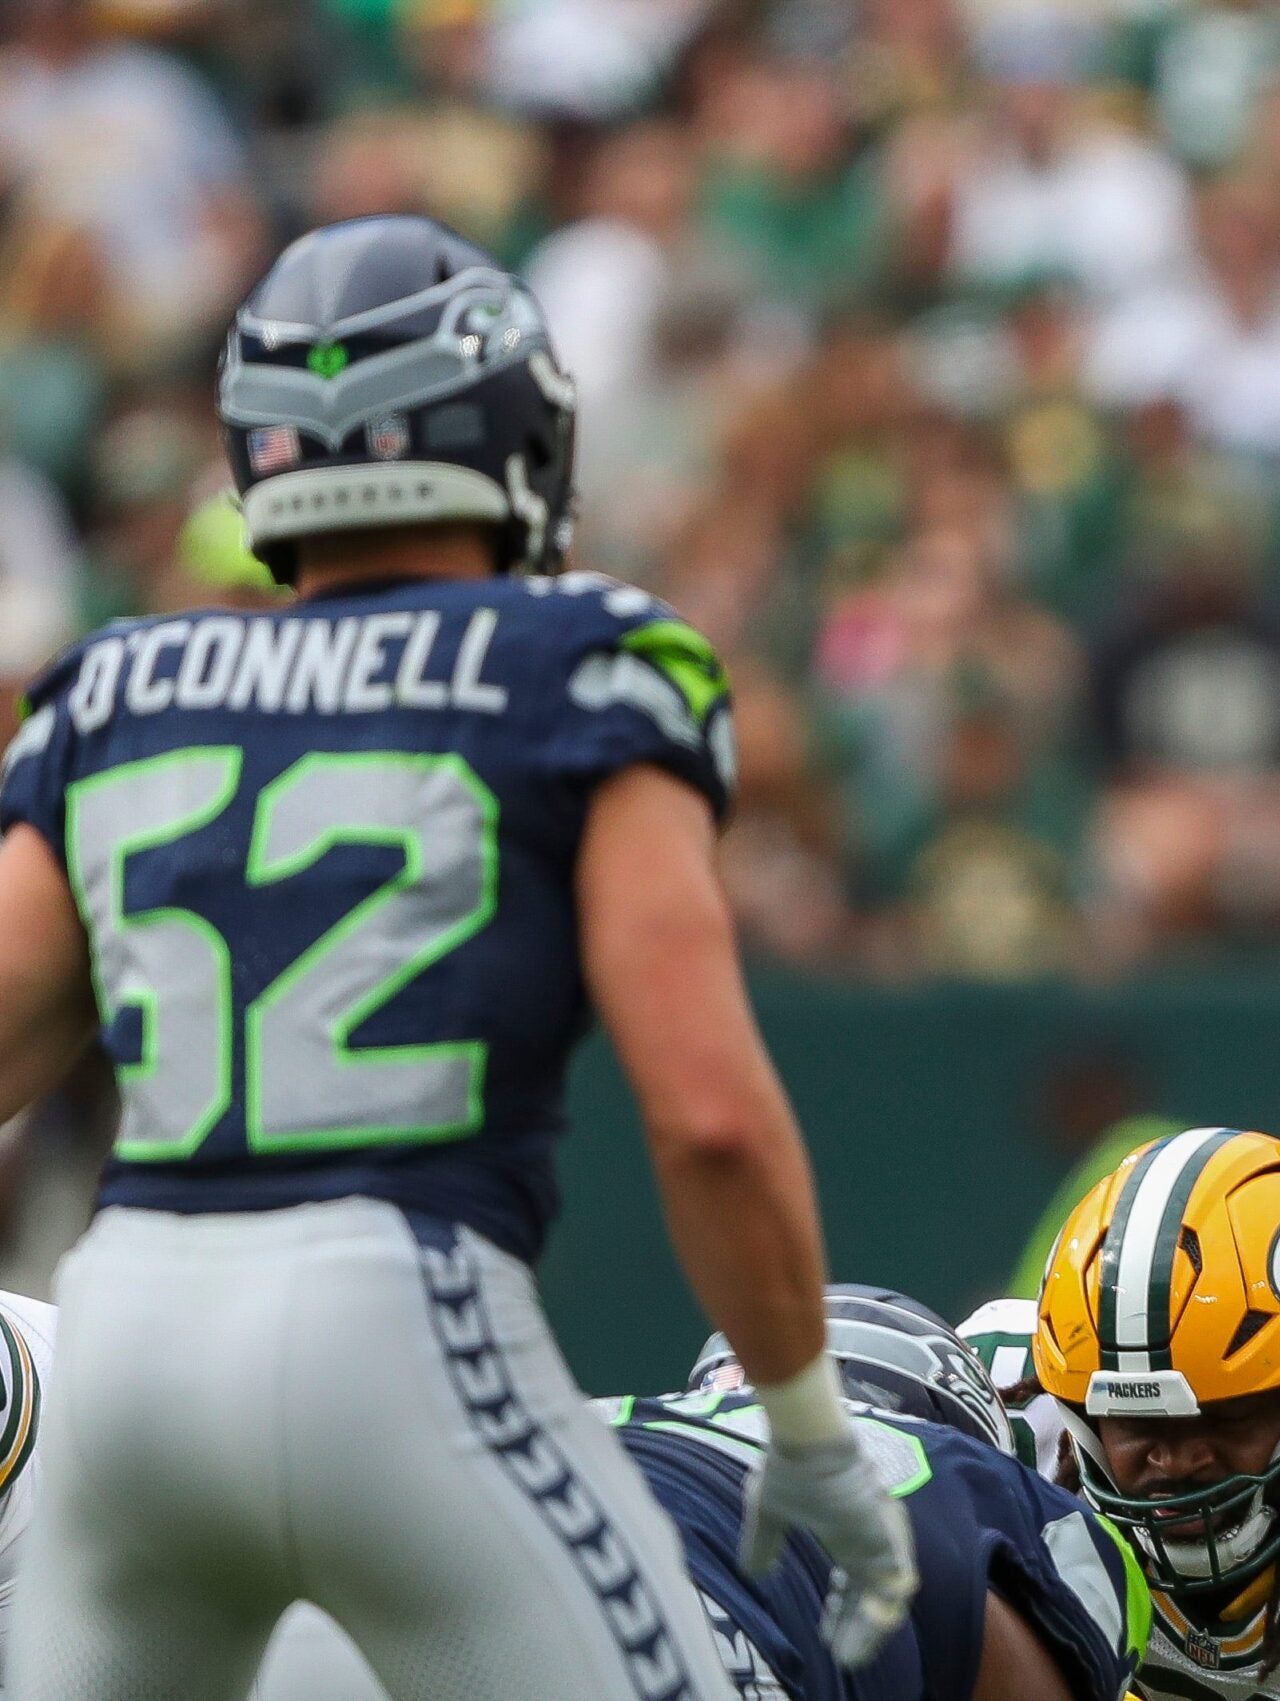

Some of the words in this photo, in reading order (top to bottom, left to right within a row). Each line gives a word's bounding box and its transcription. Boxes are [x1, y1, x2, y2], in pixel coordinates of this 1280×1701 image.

[68, 608, 509, 734] O'CONNELL
[65, 745, 500, 1163] 52
[1106, 1381, 1162, 1399] PACKERS
